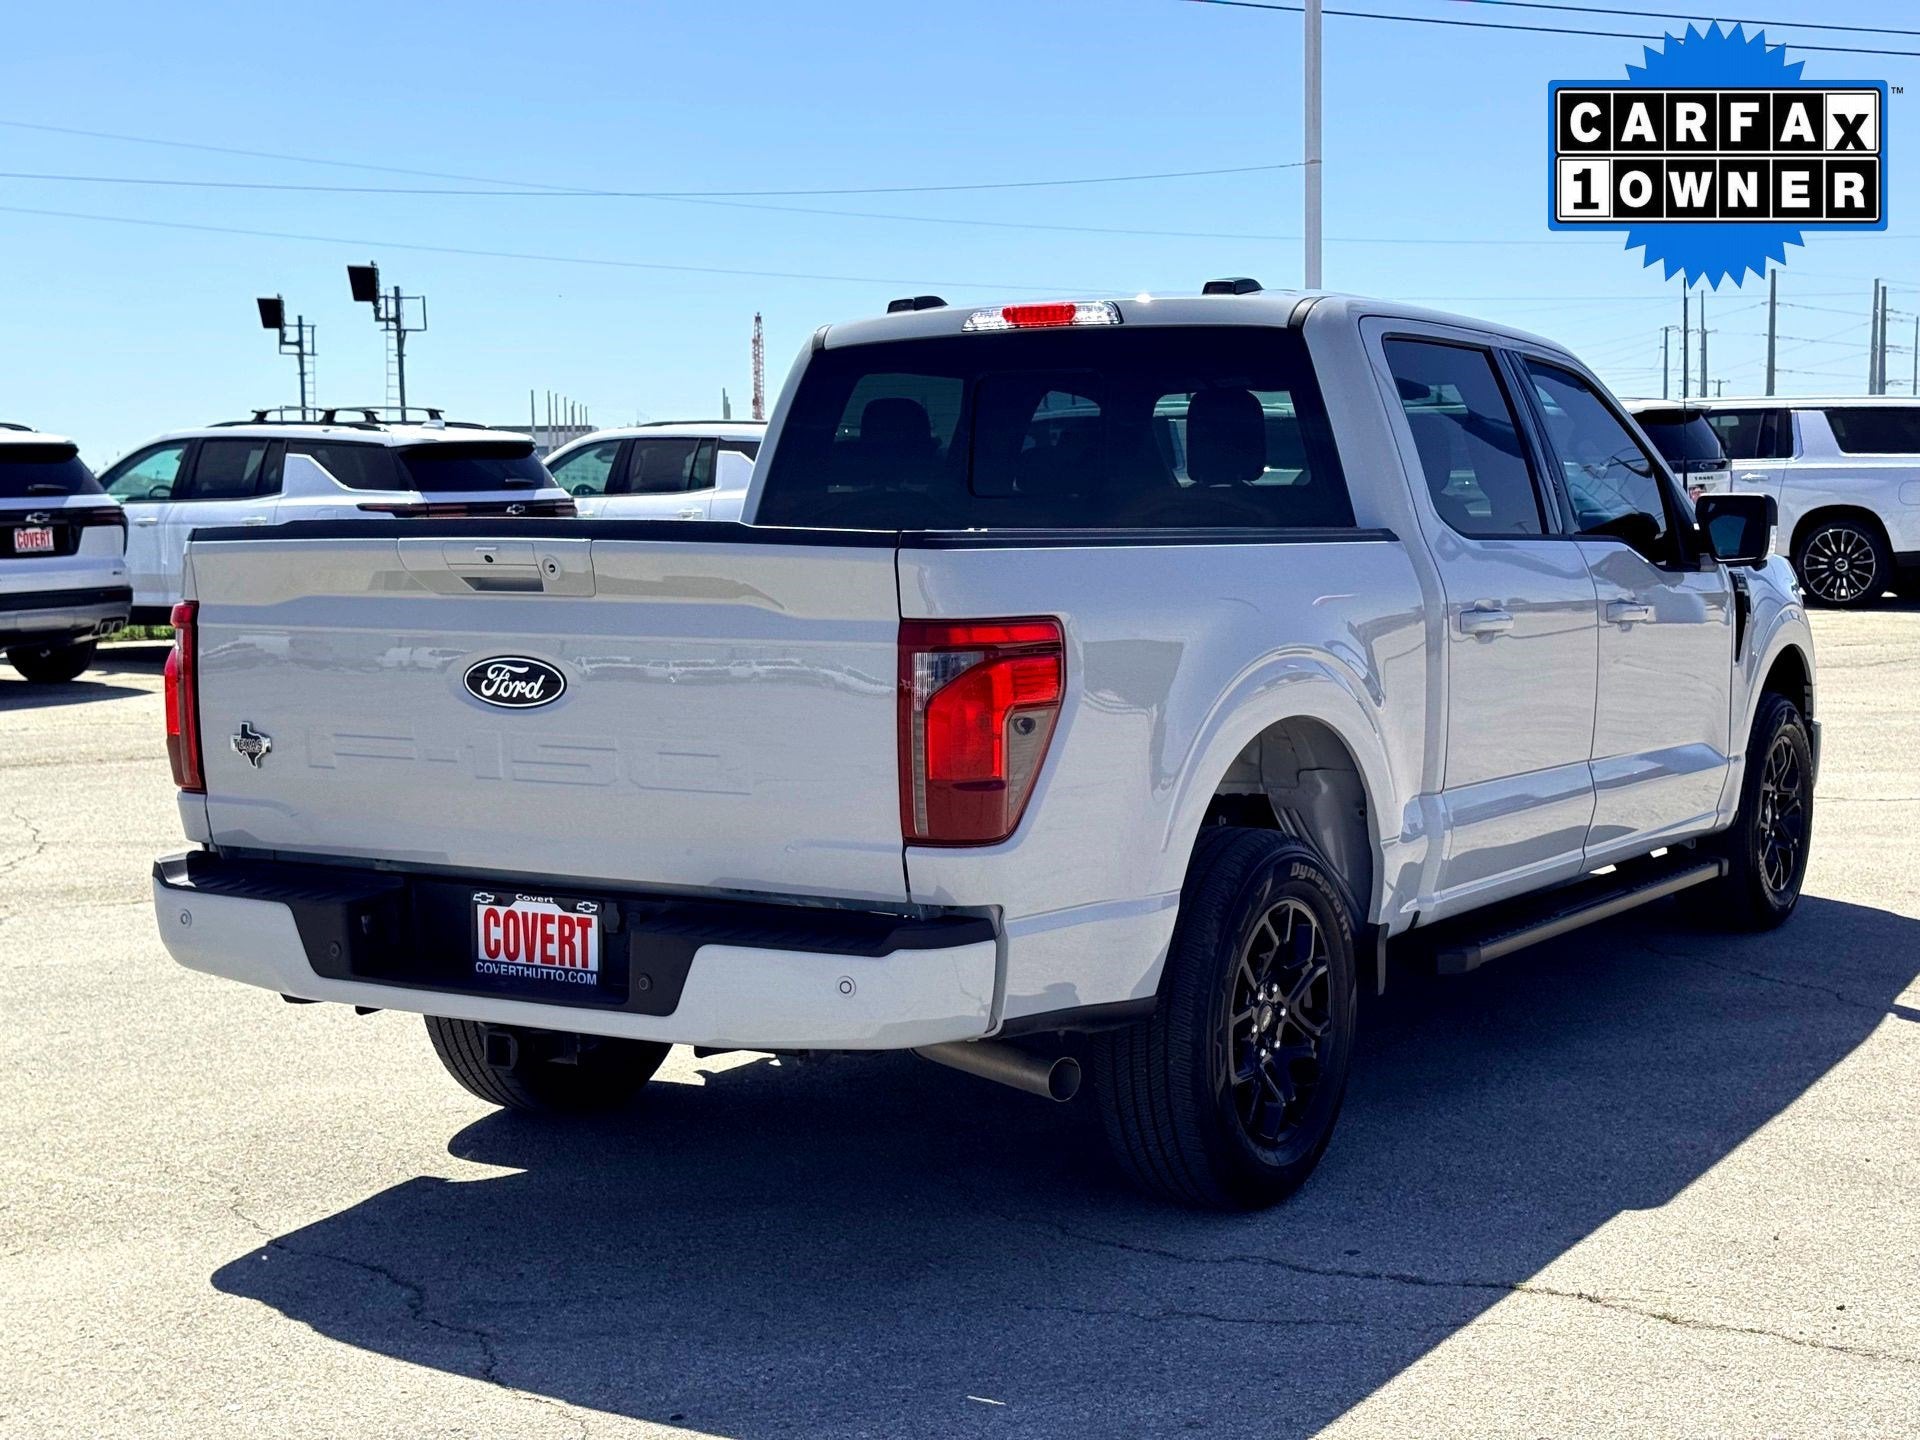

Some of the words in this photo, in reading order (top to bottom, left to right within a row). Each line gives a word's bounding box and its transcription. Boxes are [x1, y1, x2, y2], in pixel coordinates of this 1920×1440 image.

[16, 531, 51, 548] COVERT
[480, 663, 546, 699] Ford
[233, 737, 263, 752] TEXAS
[307, 724, 752, 796] F-150
[515, 893, 554, 904] Covert
[483, 907, 593, 970] COVERT
[475, 961, 597, 985] COVERTHUTTO.COM
